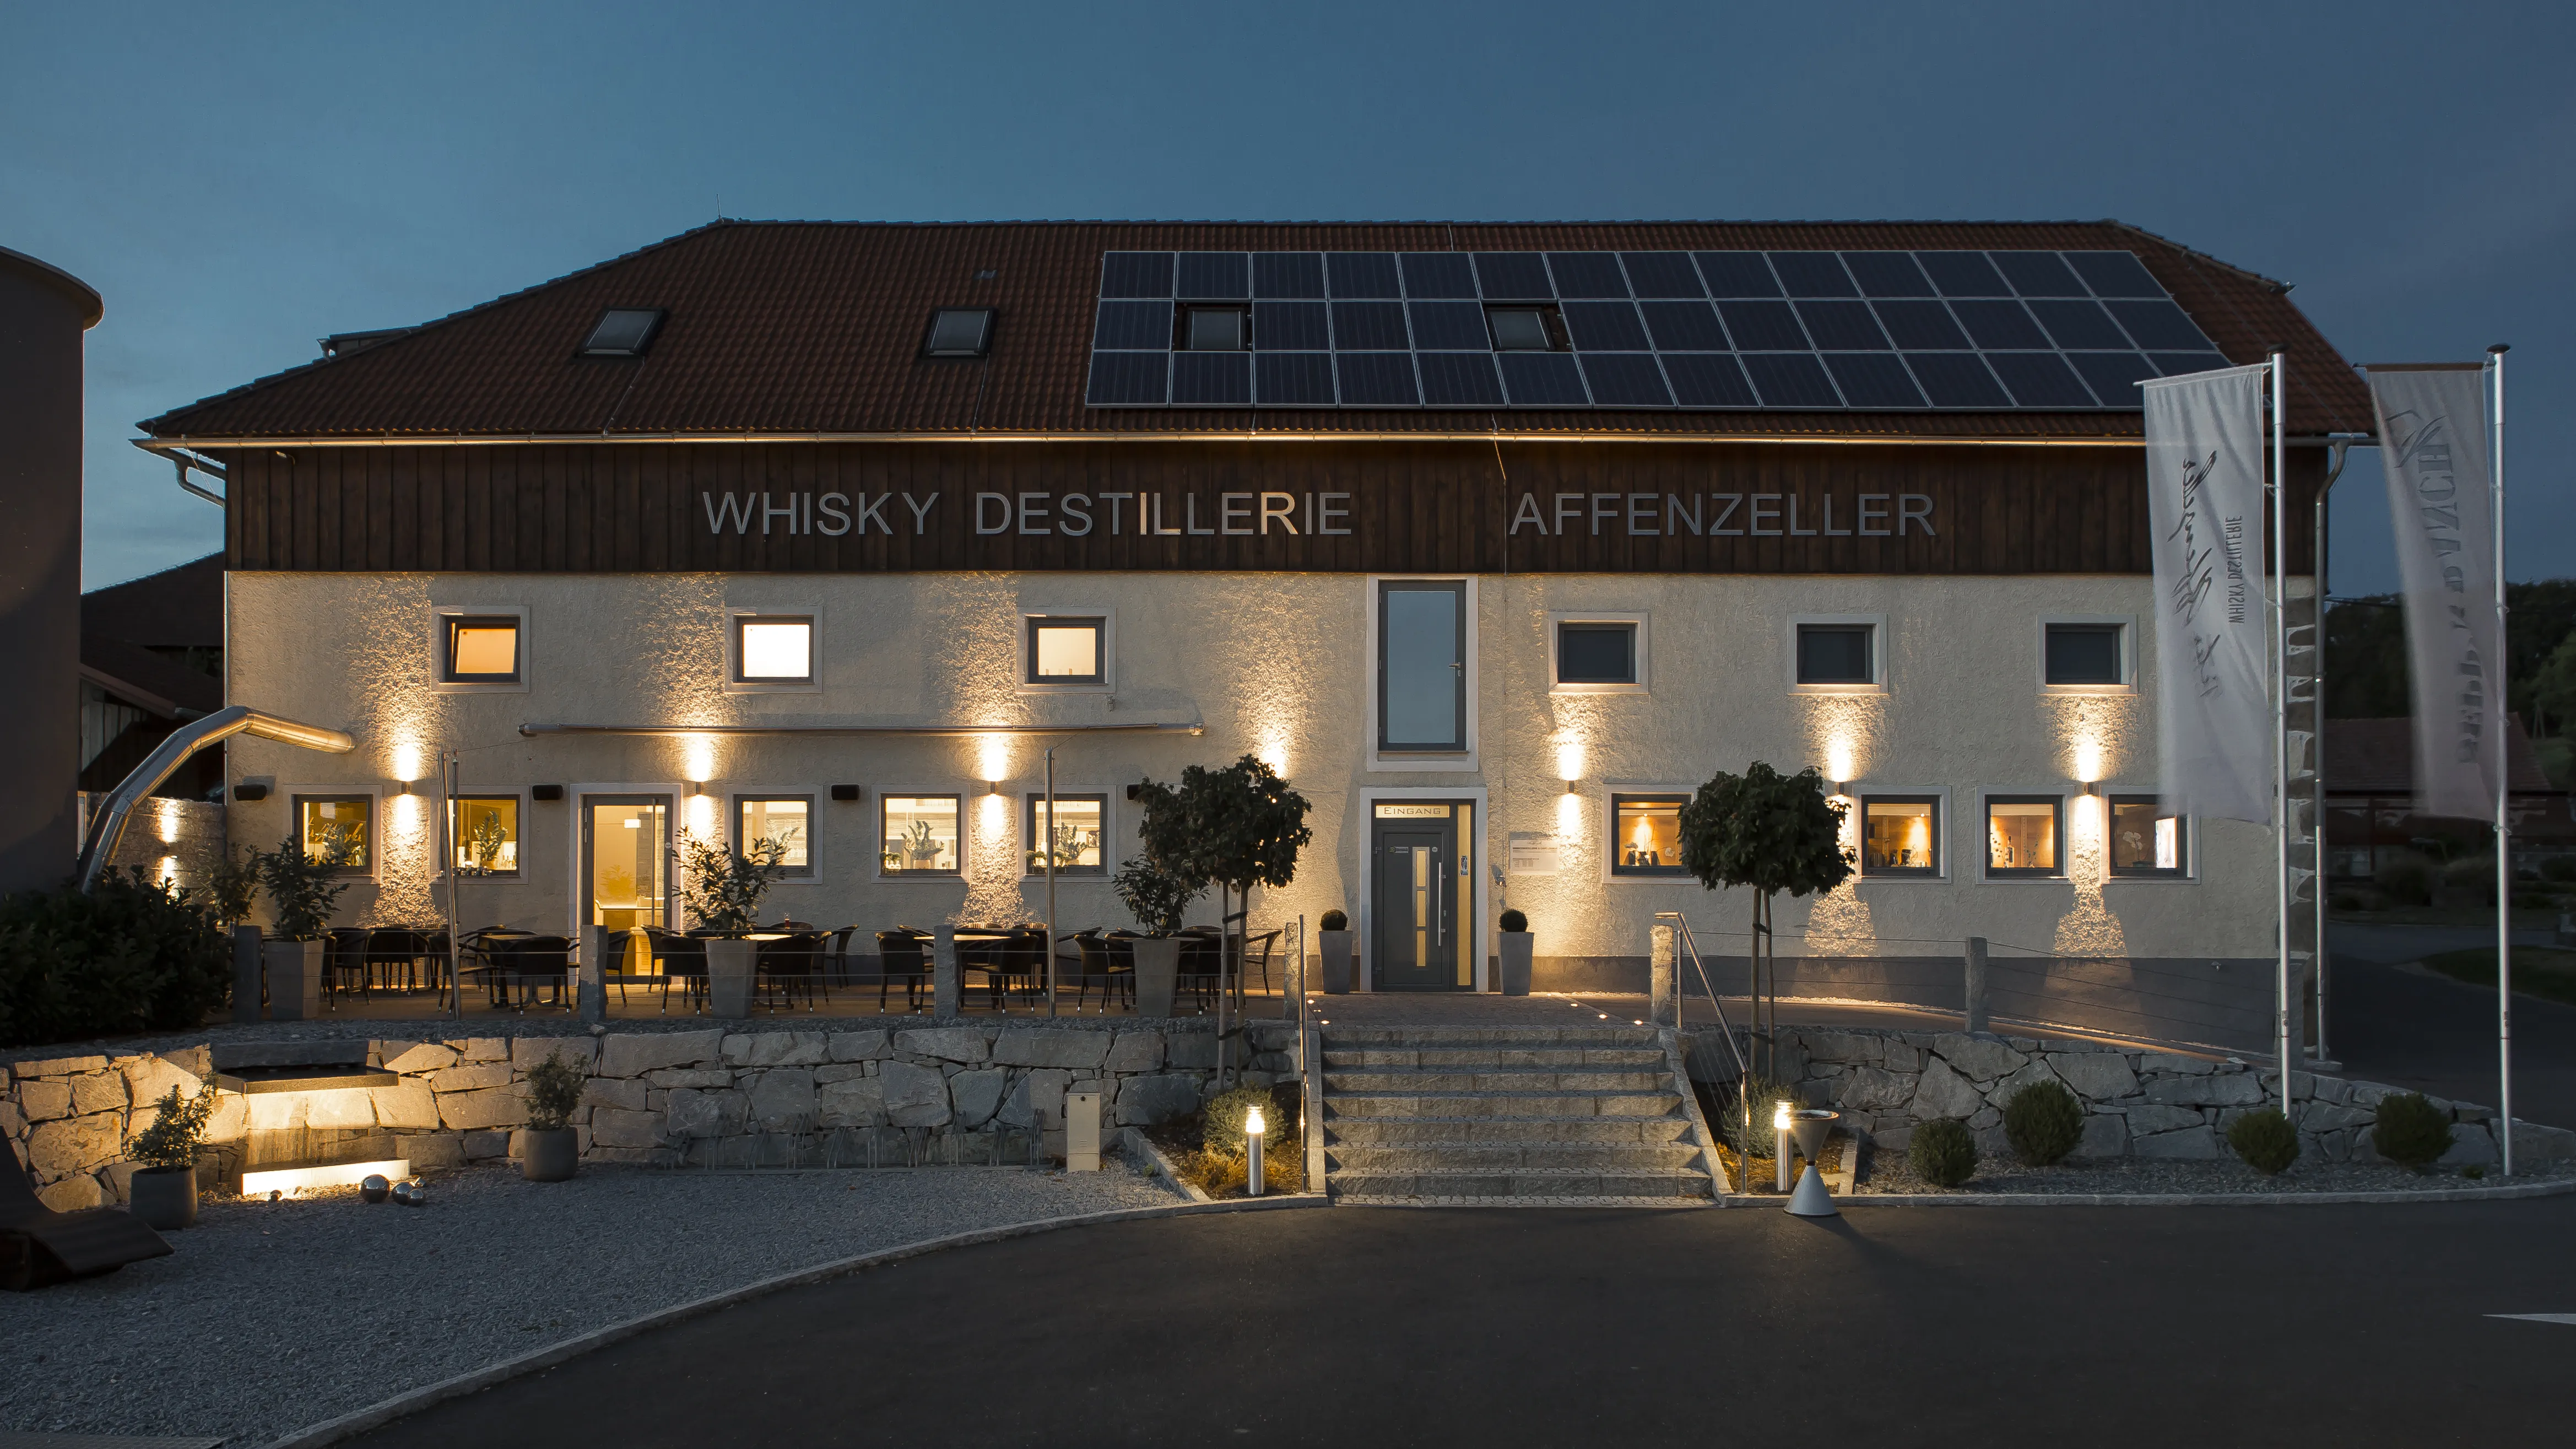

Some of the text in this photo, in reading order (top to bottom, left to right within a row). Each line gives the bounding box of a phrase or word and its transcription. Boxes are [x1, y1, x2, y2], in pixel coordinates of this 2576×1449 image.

[702, 492, 1936, 536] WHISKY DESTILLERIE AFFENZELLER
